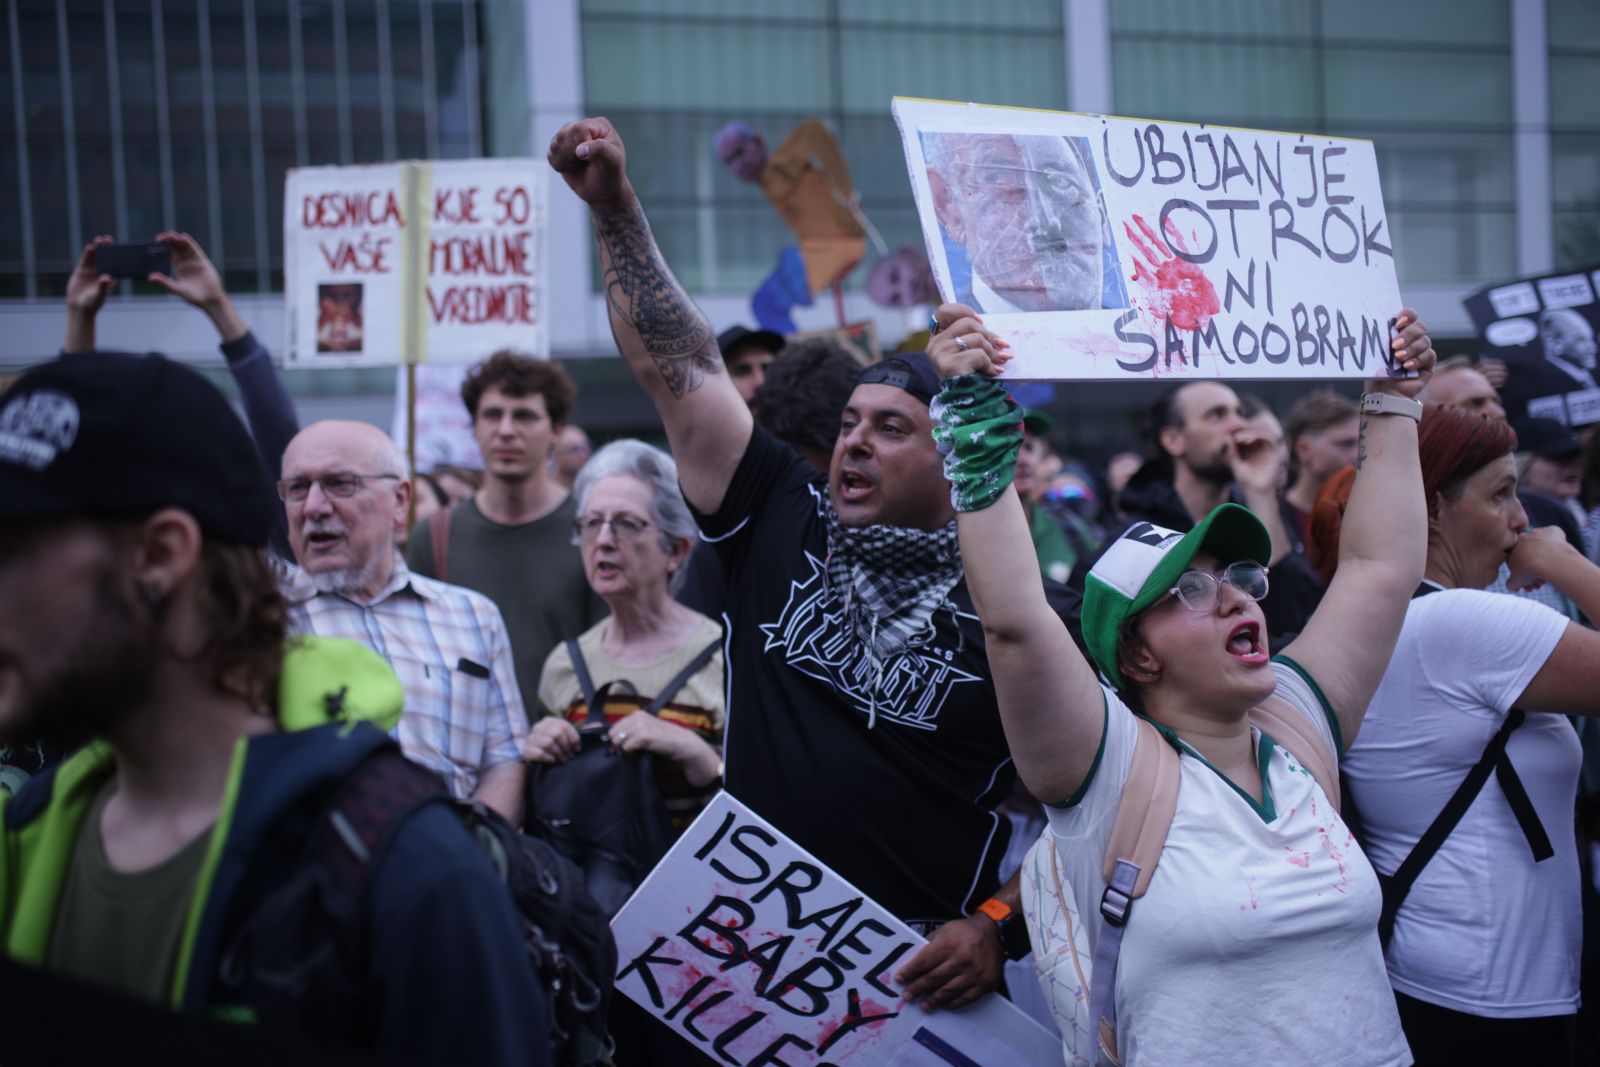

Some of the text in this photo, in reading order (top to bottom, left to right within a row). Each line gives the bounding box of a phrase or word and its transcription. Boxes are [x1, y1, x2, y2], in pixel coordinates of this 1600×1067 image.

[433, 186, 480, 224] KJE
[494, 186, 530, 225] SO
[1158, 197, 1393, 266] OTROK
[319, 231, 533, 276] VAŠE MORALNE
[1224, 256, 1274, 314] NI
[425, 283, 536, 325] VREDNOTE
[693, 810, 916, 999] ISRAEL
[615, 936, 838, 1067] KILLE
[676, 894, 900, 1056] BABY
